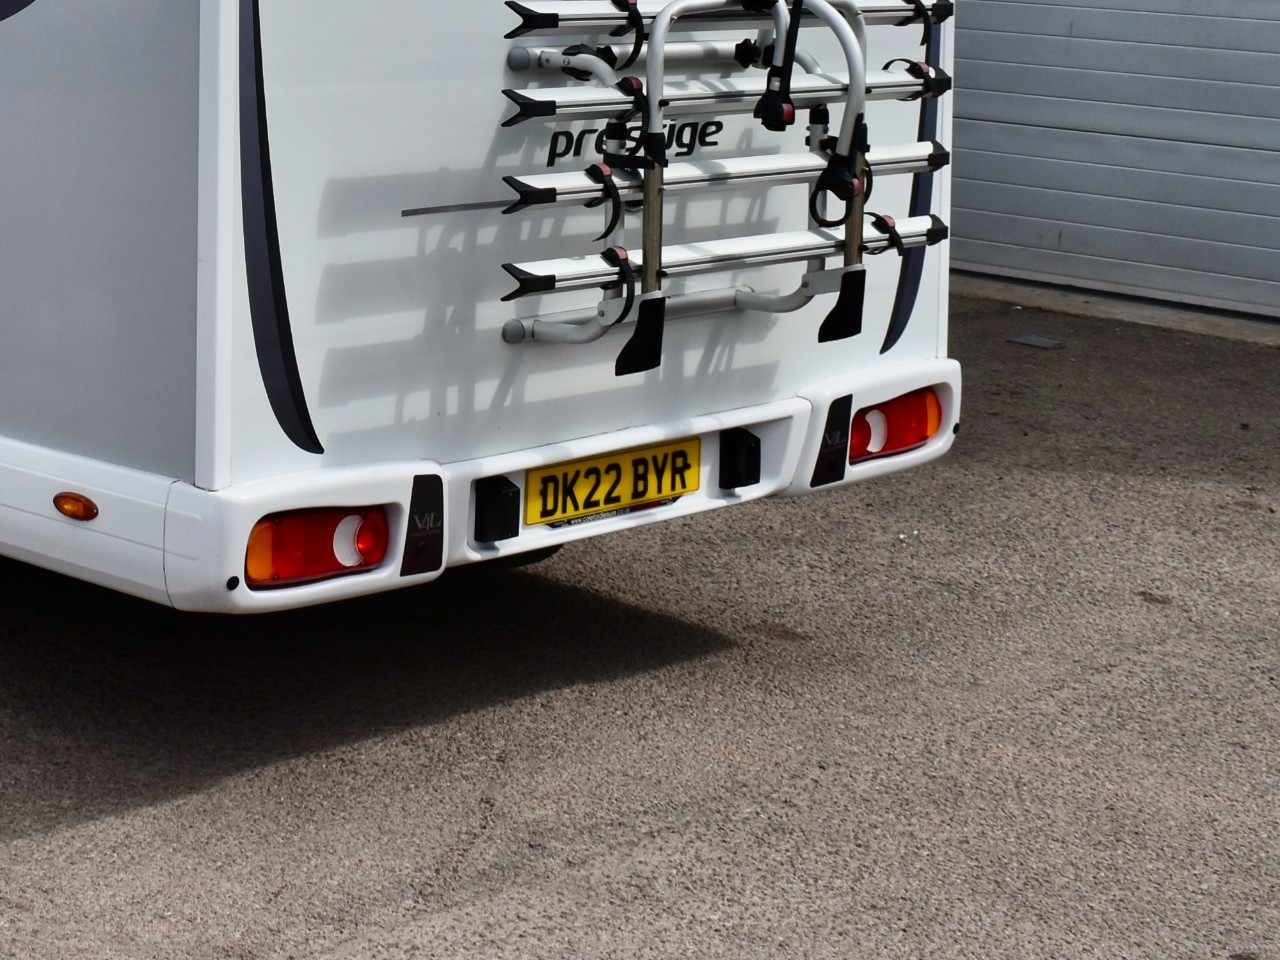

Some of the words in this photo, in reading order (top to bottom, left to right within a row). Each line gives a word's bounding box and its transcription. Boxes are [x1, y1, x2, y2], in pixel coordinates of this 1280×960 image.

[546, 119, 724, 168] prsige
[540, 462, 622, 519] DK22
[631, 450, 691, 500] BYR
